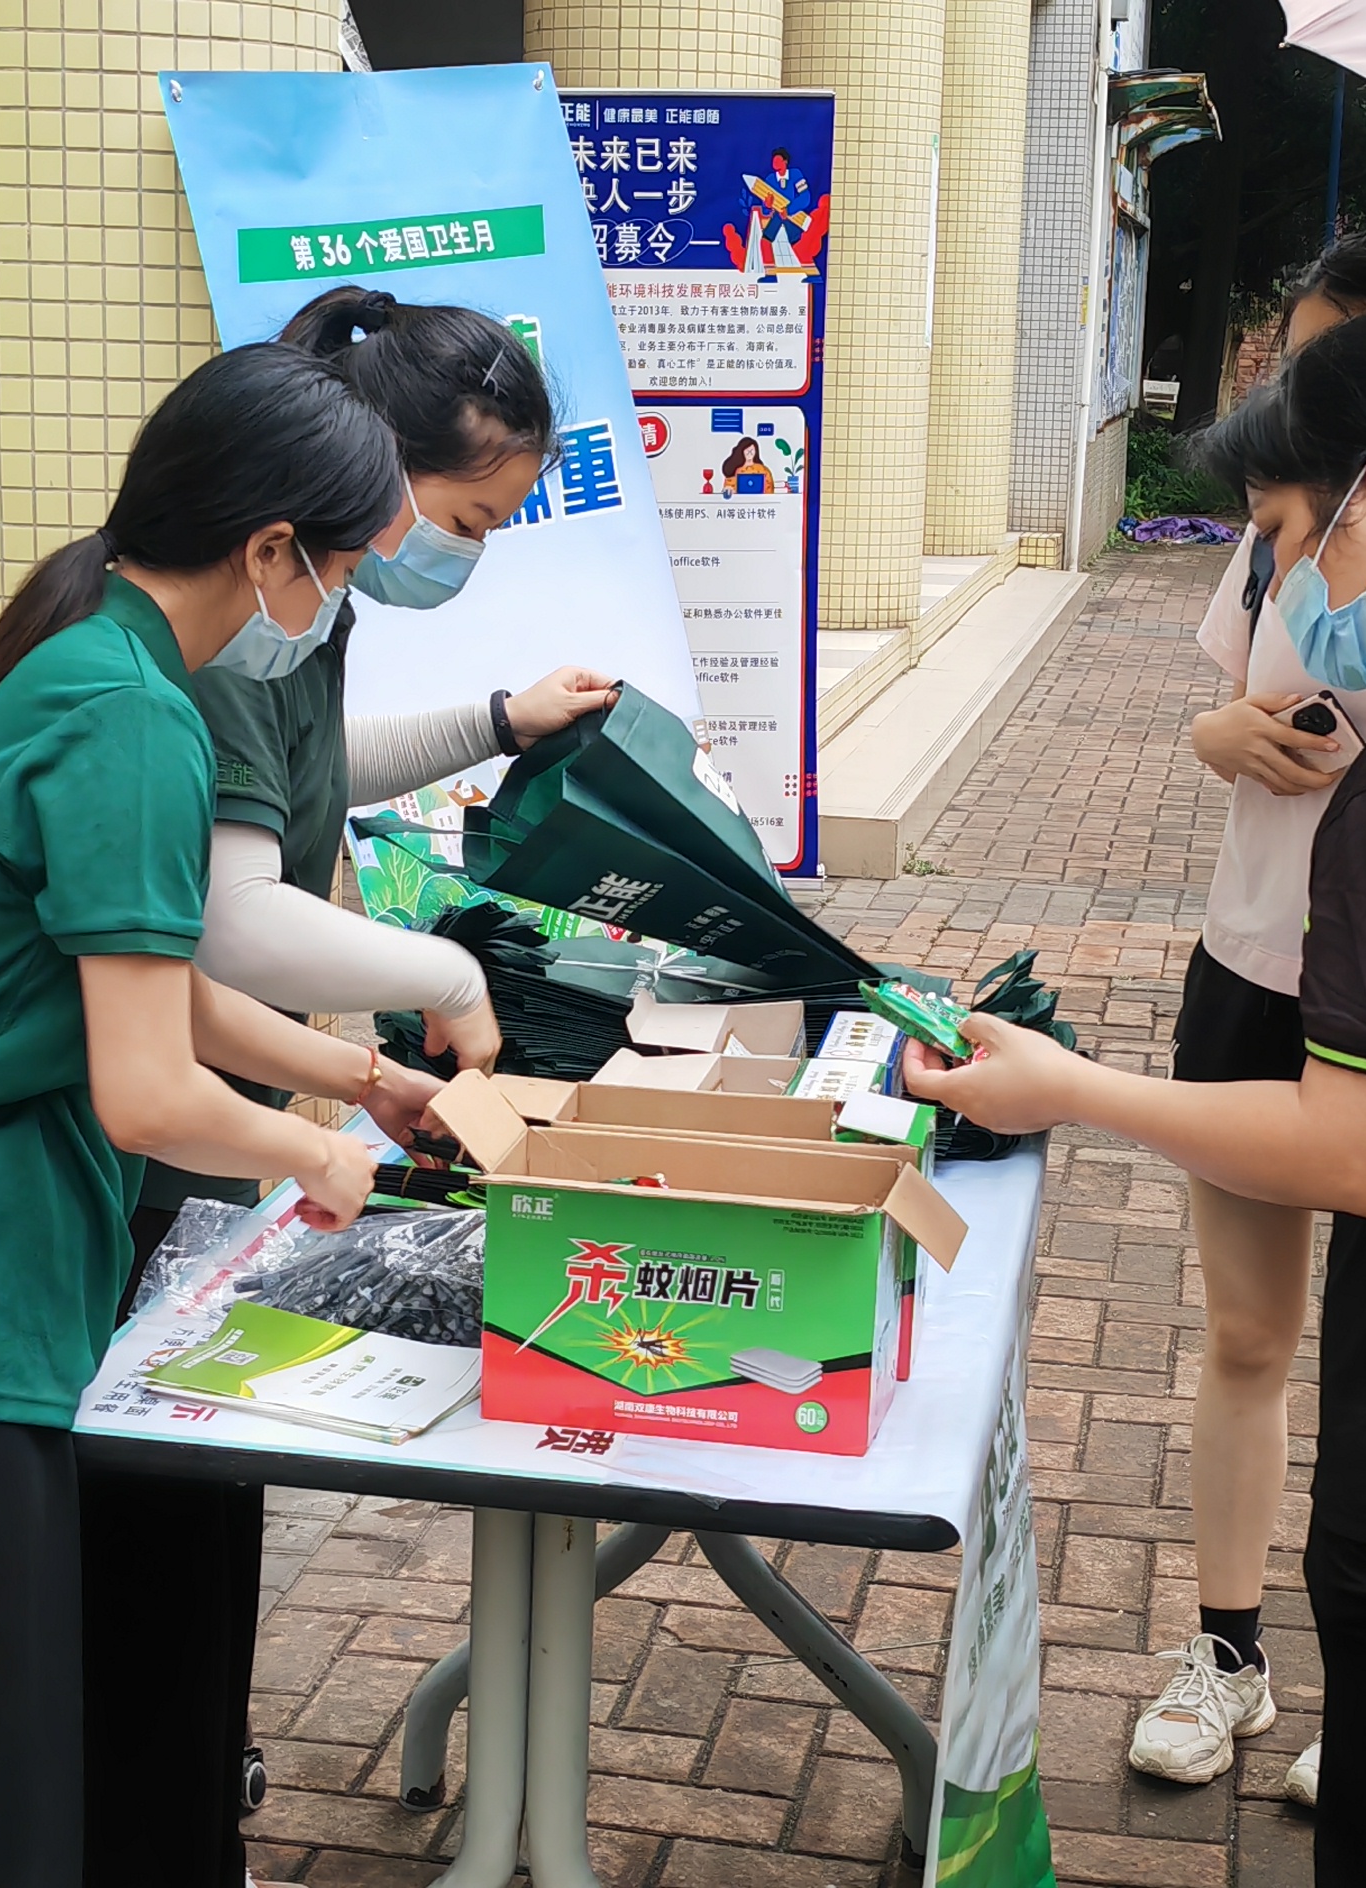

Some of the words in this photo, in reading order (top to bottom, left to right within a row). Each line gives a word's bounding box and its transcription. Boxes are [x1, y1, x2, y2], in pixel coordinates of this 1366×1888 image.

[603, 107, 658, 124] 健康最美
[665, 107, 721, 125] 正能相随
[571, 135, 697, 174] 未来已来
[659, 508, 776, 520] 练使用PS、AI等设计软件
[511, 1192, 554, 1216] 欣正
[797, 1406, 817, 1426] 60
